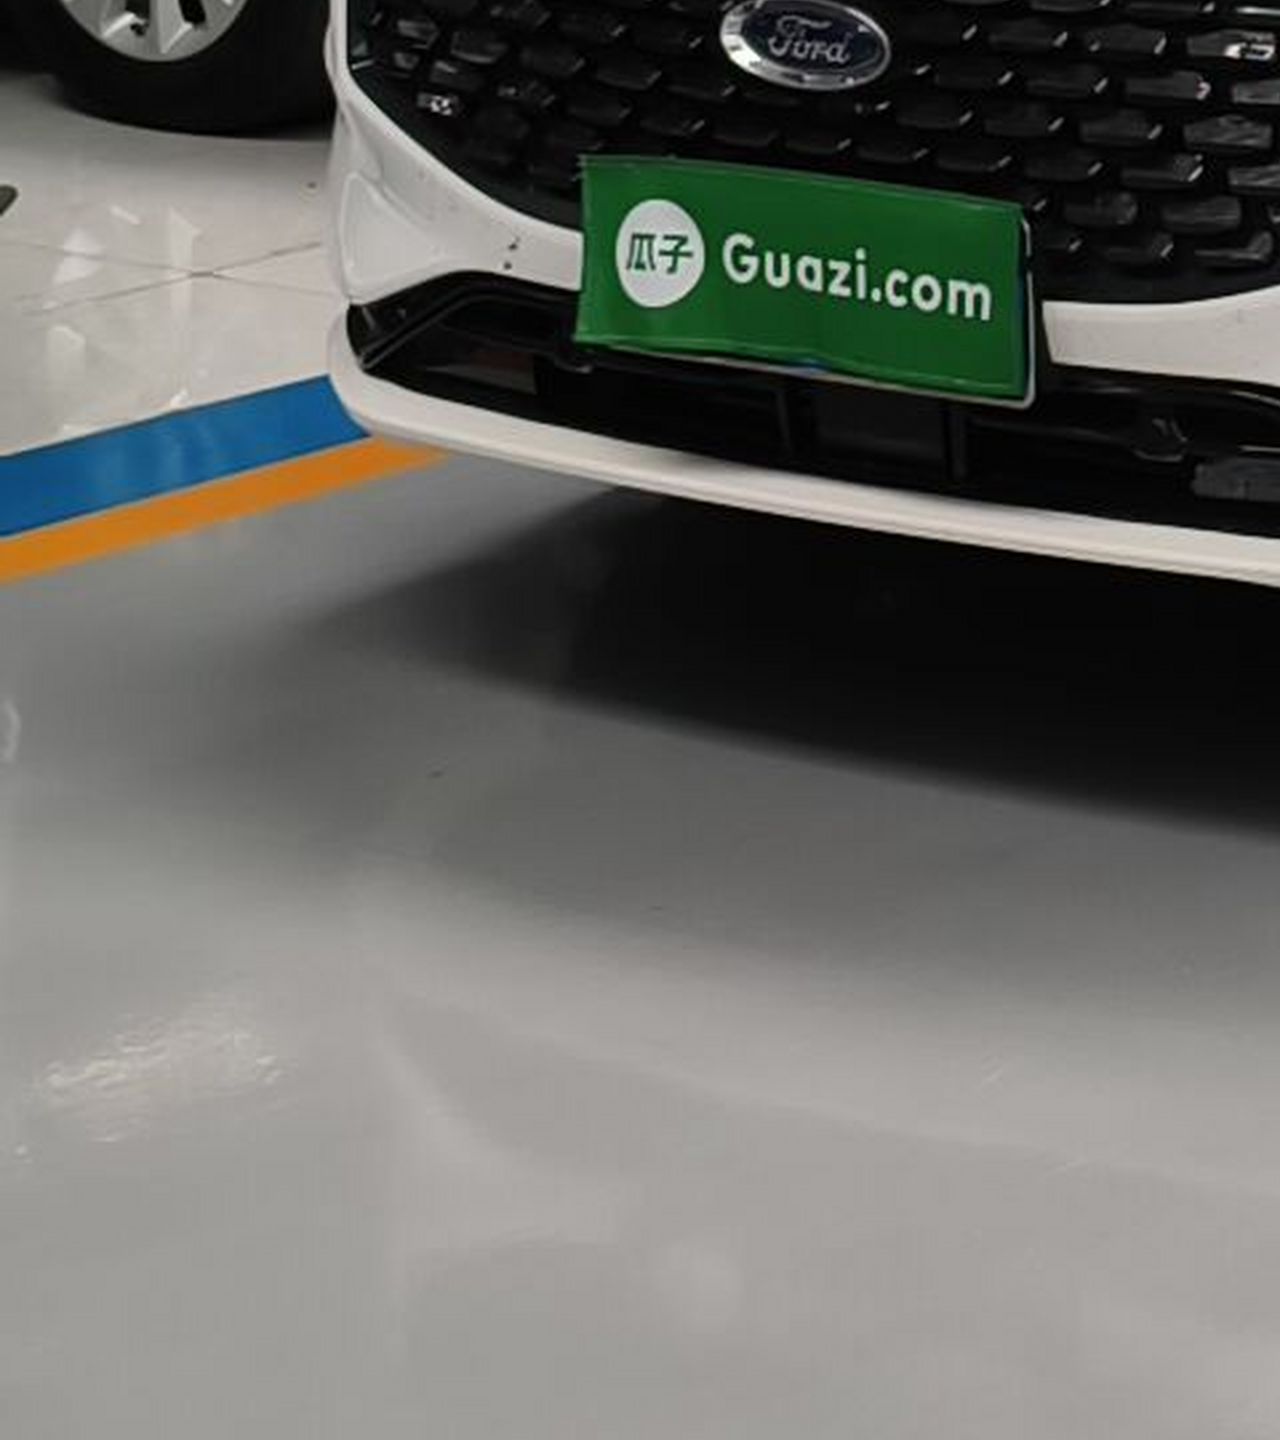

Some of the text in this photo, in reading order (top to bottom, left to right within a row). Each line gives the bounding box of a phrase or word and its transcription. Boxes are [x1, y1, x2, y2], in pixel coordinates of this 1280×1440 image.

[767, 14, 853, 64] Ford
[626, 232, 992, 321] 瓜子 Guazi.com
